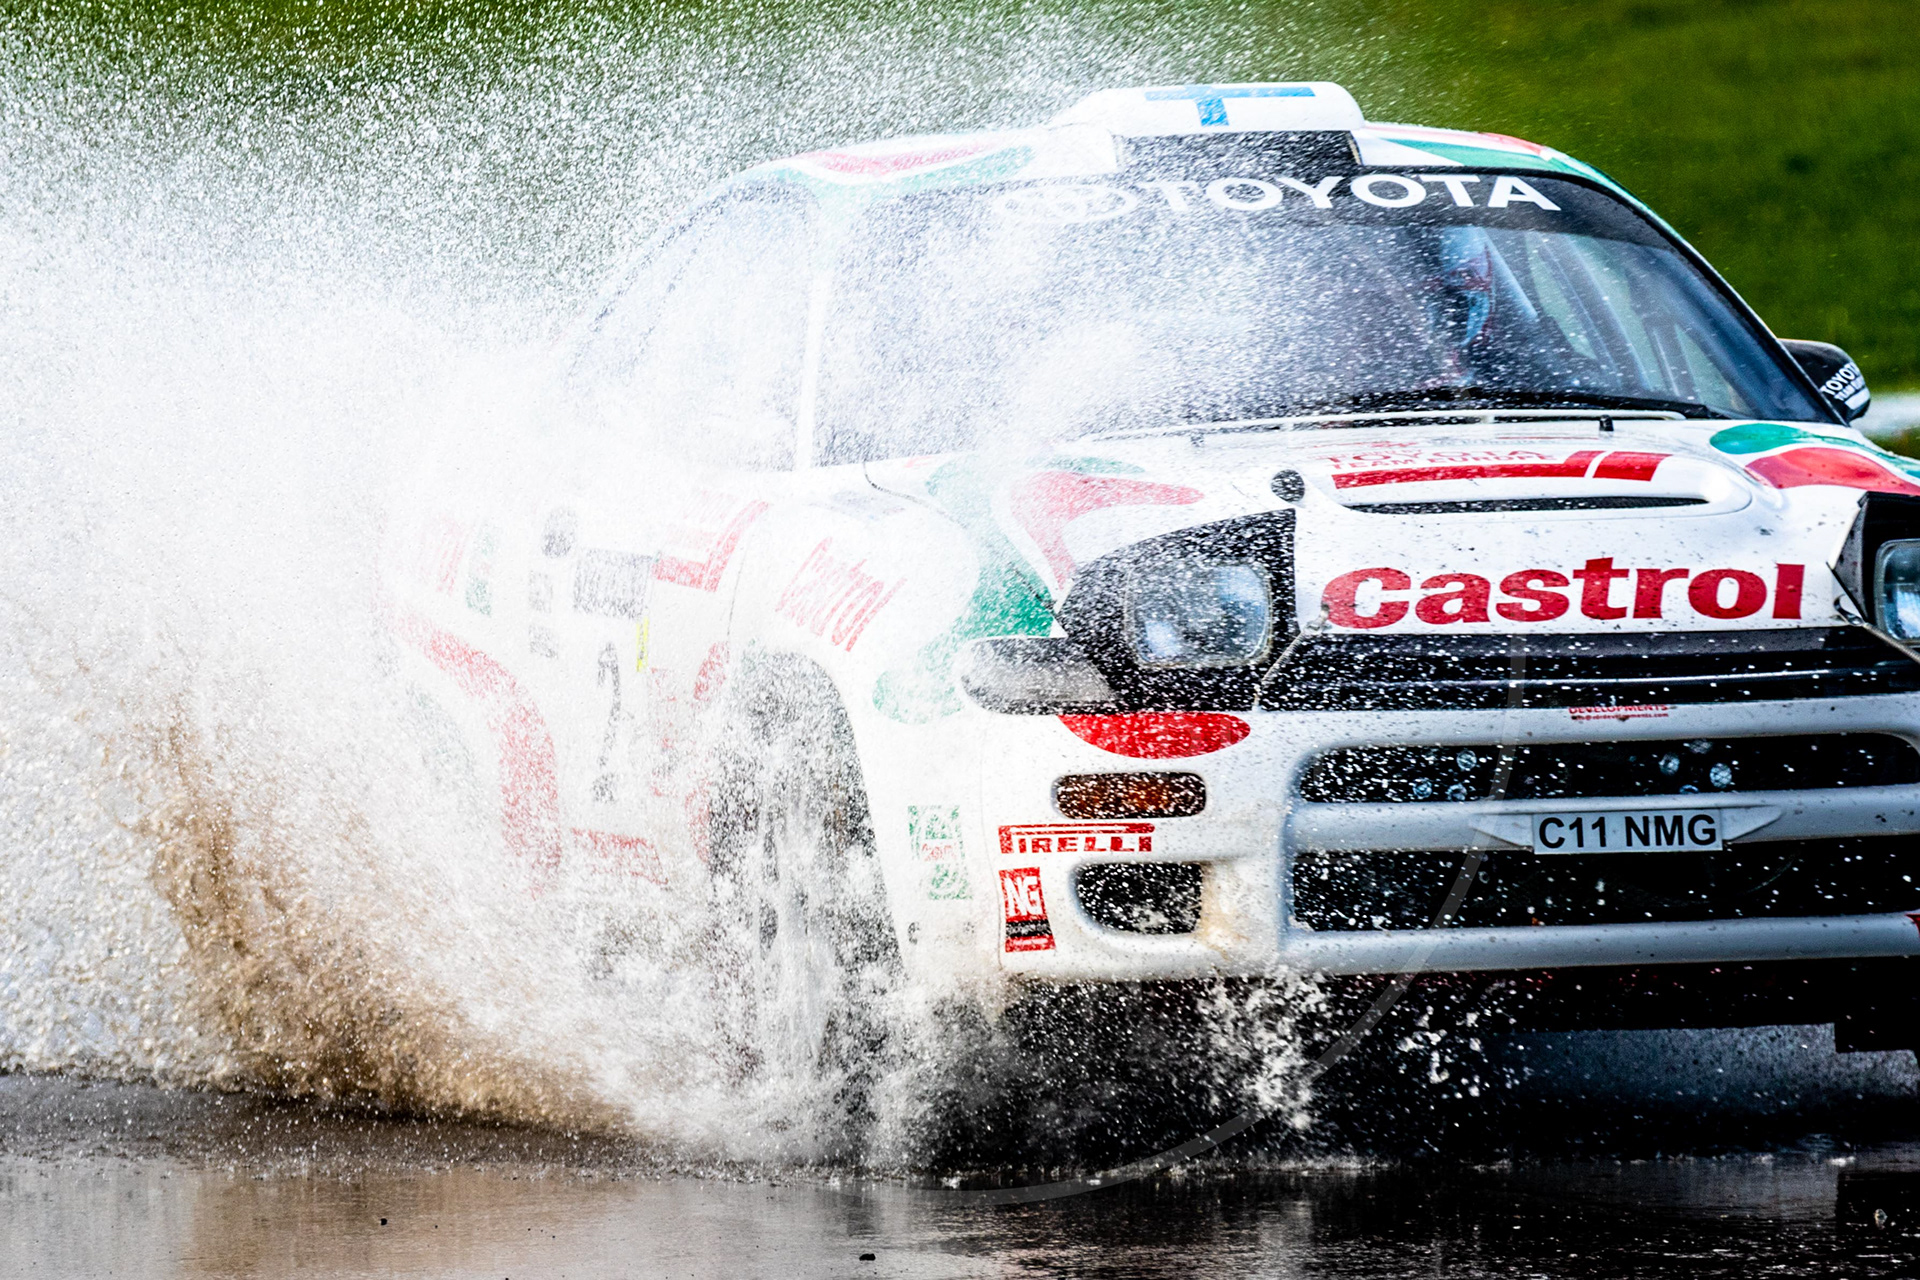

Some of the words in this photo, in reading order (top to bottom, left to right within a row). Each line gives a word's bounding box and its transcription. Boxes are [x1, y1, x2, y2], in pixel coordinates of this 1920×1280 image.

[1140, 173, 1563, 212] TOYOTA
[1324, 450, 1546, 463] TOYOTA
[1330, 459, 1417, 470] TEAM
[1427, 454, 1558, 465] EUROPE
[1569, 704, 1668, 714] DEVELOPMENTS
[998, 823, 1155, 854] PIRELLI
[1539, 816, 1606, 849] C11
[1625, 814, 1716, 846] NMG
